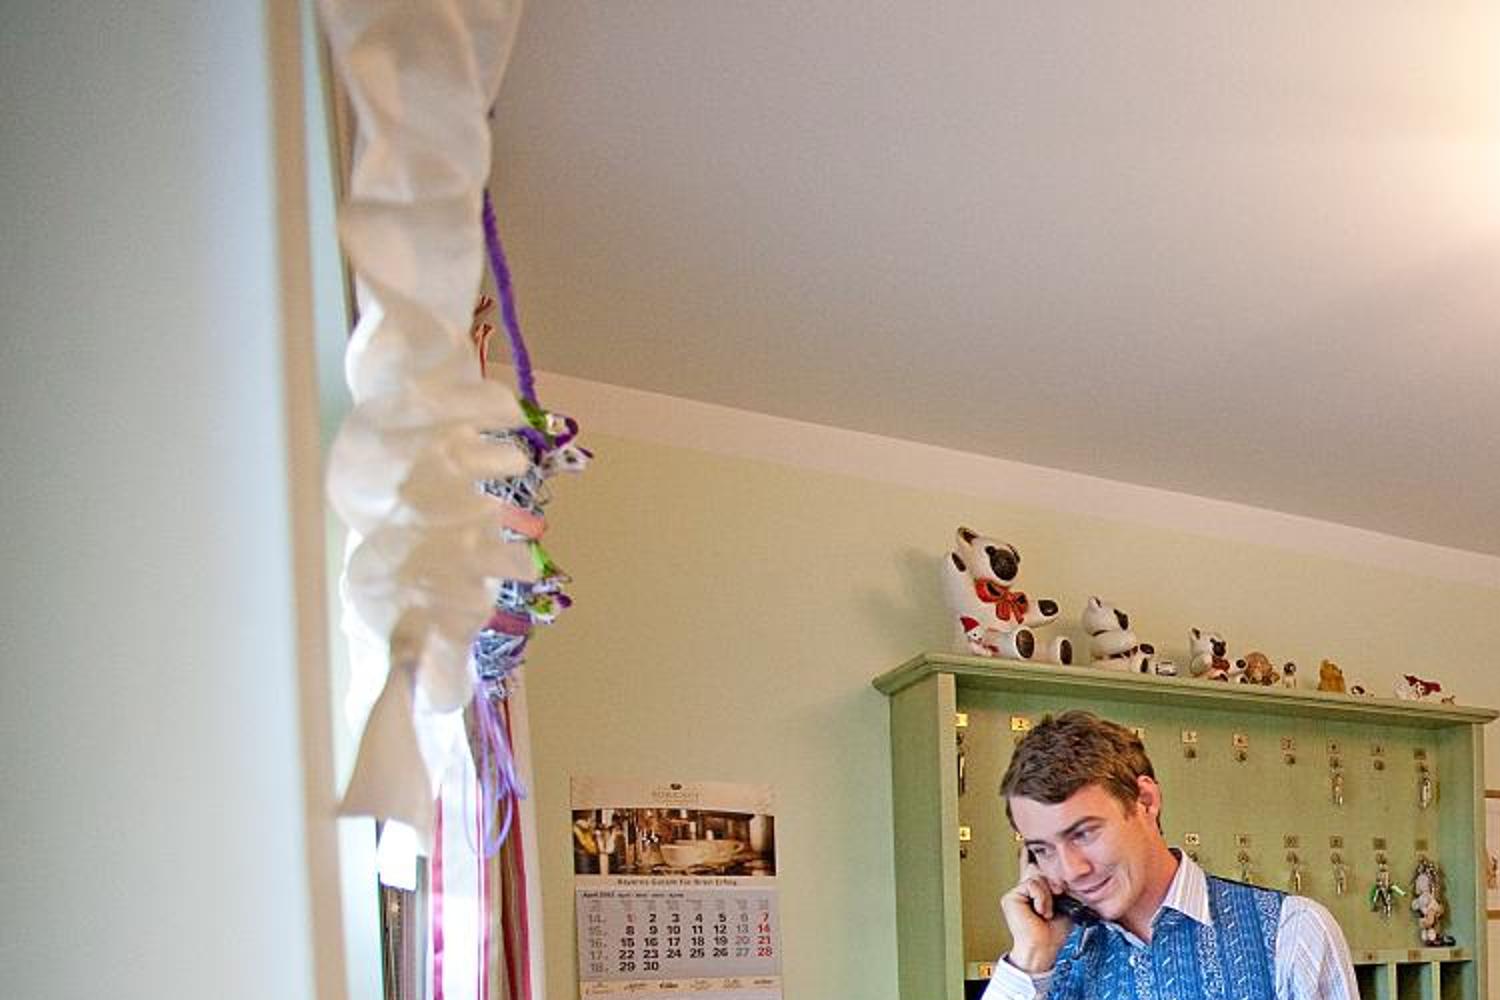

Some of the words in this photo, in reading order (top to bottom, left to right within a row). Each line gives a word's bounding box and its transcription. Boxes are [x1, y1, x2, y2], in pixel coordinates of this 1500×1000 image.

[649, 913, 657, 923] 2
[671, 913, 680, 923] 3
[695, 913, 703, 923] 4
[719, 913, 727, 922] 5
[762, 912, 769, 922] 7
[625, 925, 635, 936] 8
[649, 926, 658, 935] 9
[667, 926, 681, 935] 10
[692, 924, 703, 934] 11
[714, 924, 727, 934] 12
[620, 938, 635, 947] 15
[644, 937, 658, 946] 16
[667, 937, 681, 946] 17
[691, 936, 705, 946] 18
[714, 936, 728, 945] 19
[736, 936, 750, 945] 20
[758, 935, 770, 944] 21
[619, 949, 635, 959] 22
[643, 949, 659, 958] 23
[666, 949, 682, 958] 24
[690, 947, 705, 958] 25
[713, 947, 729, 957] 26
[736, 947, 750, 957] 27
[758, 946, 773, 957] 28
[619, 961, 636, 971] 29
[643, 961, 659, 971] 30
